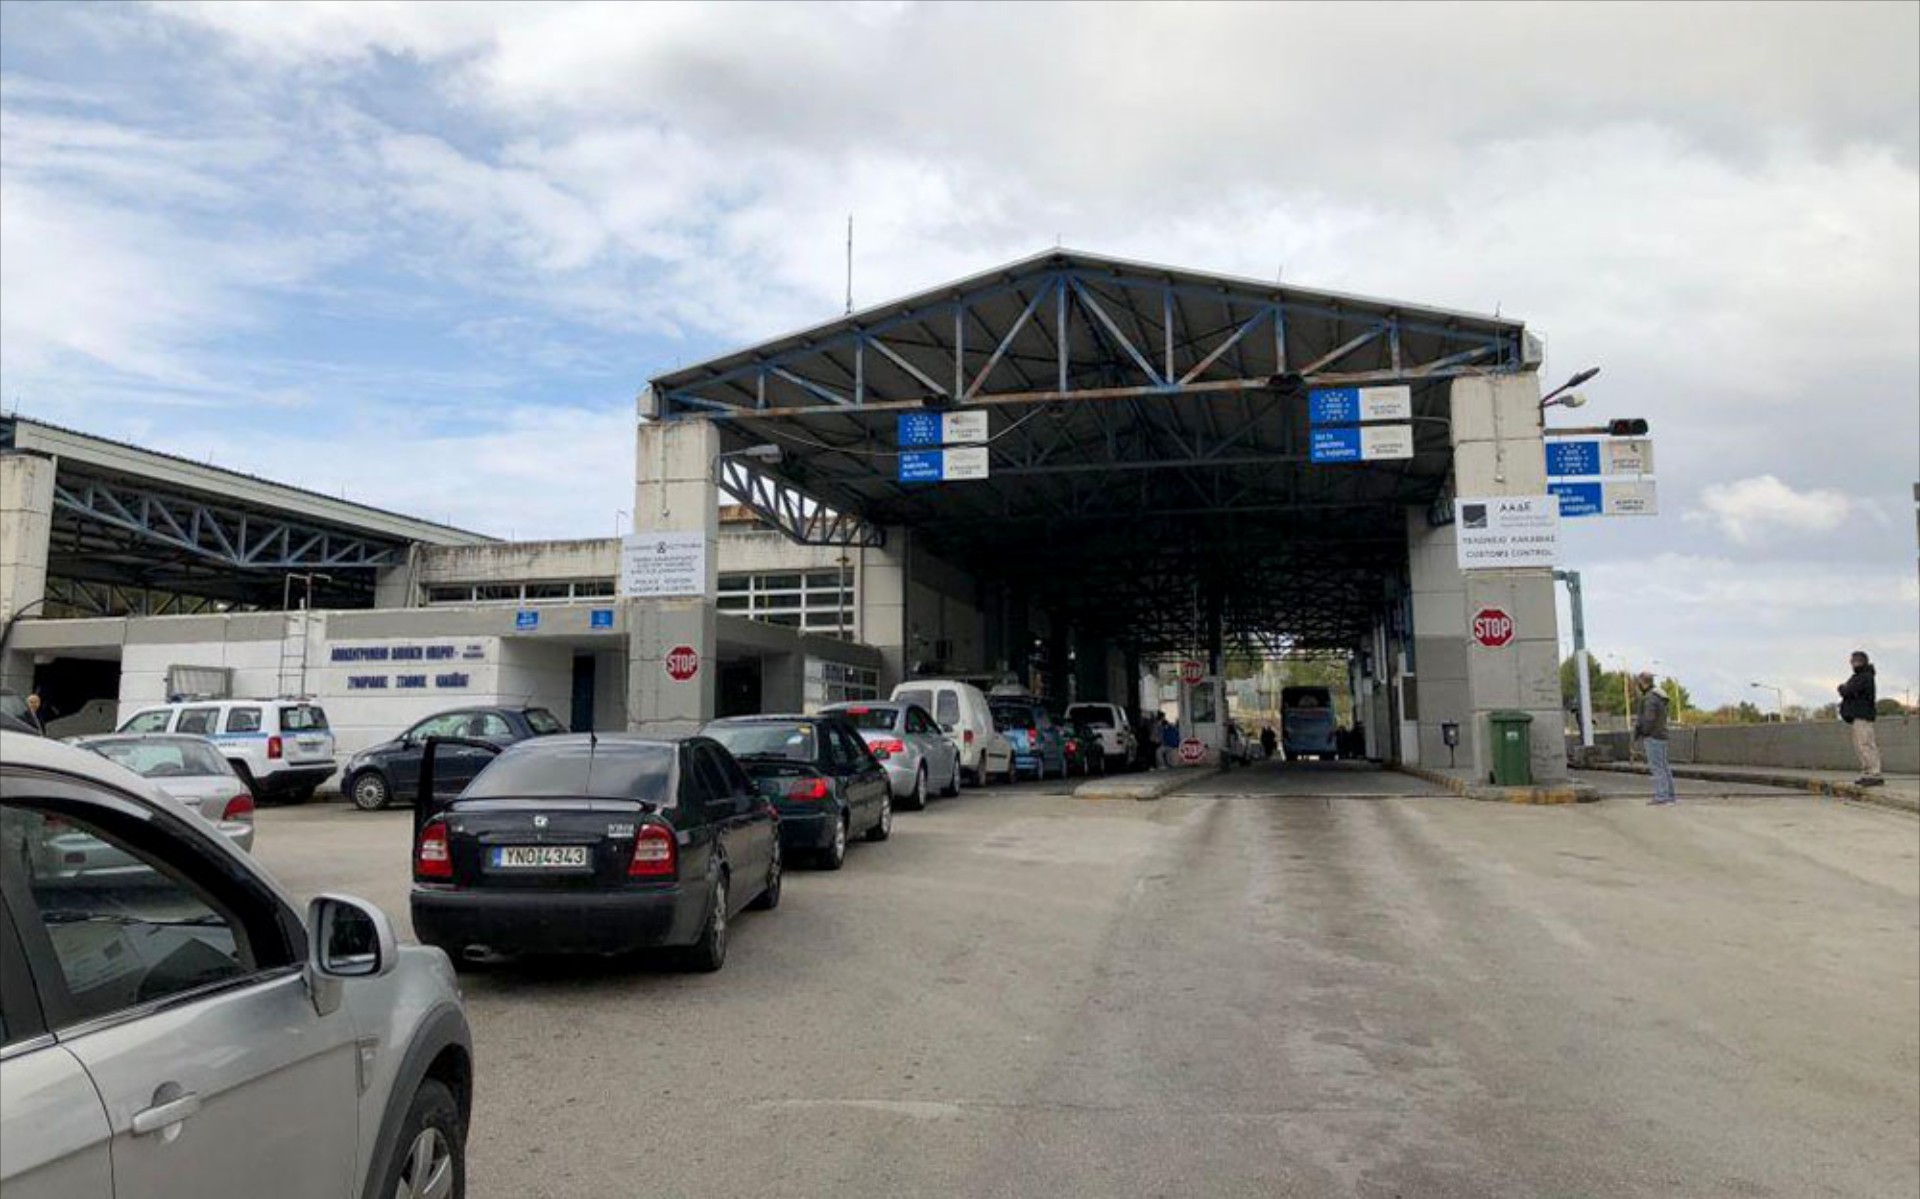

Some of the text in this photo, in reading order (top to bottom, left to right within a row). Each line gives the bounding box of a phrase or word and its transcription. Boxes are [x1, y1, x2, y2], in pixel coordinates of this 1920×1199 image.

[1511, 549, 1554, 558] CONTROL
[1475, 617, 1510, 639] STOP
[667, 654, 697, 673] STOP
